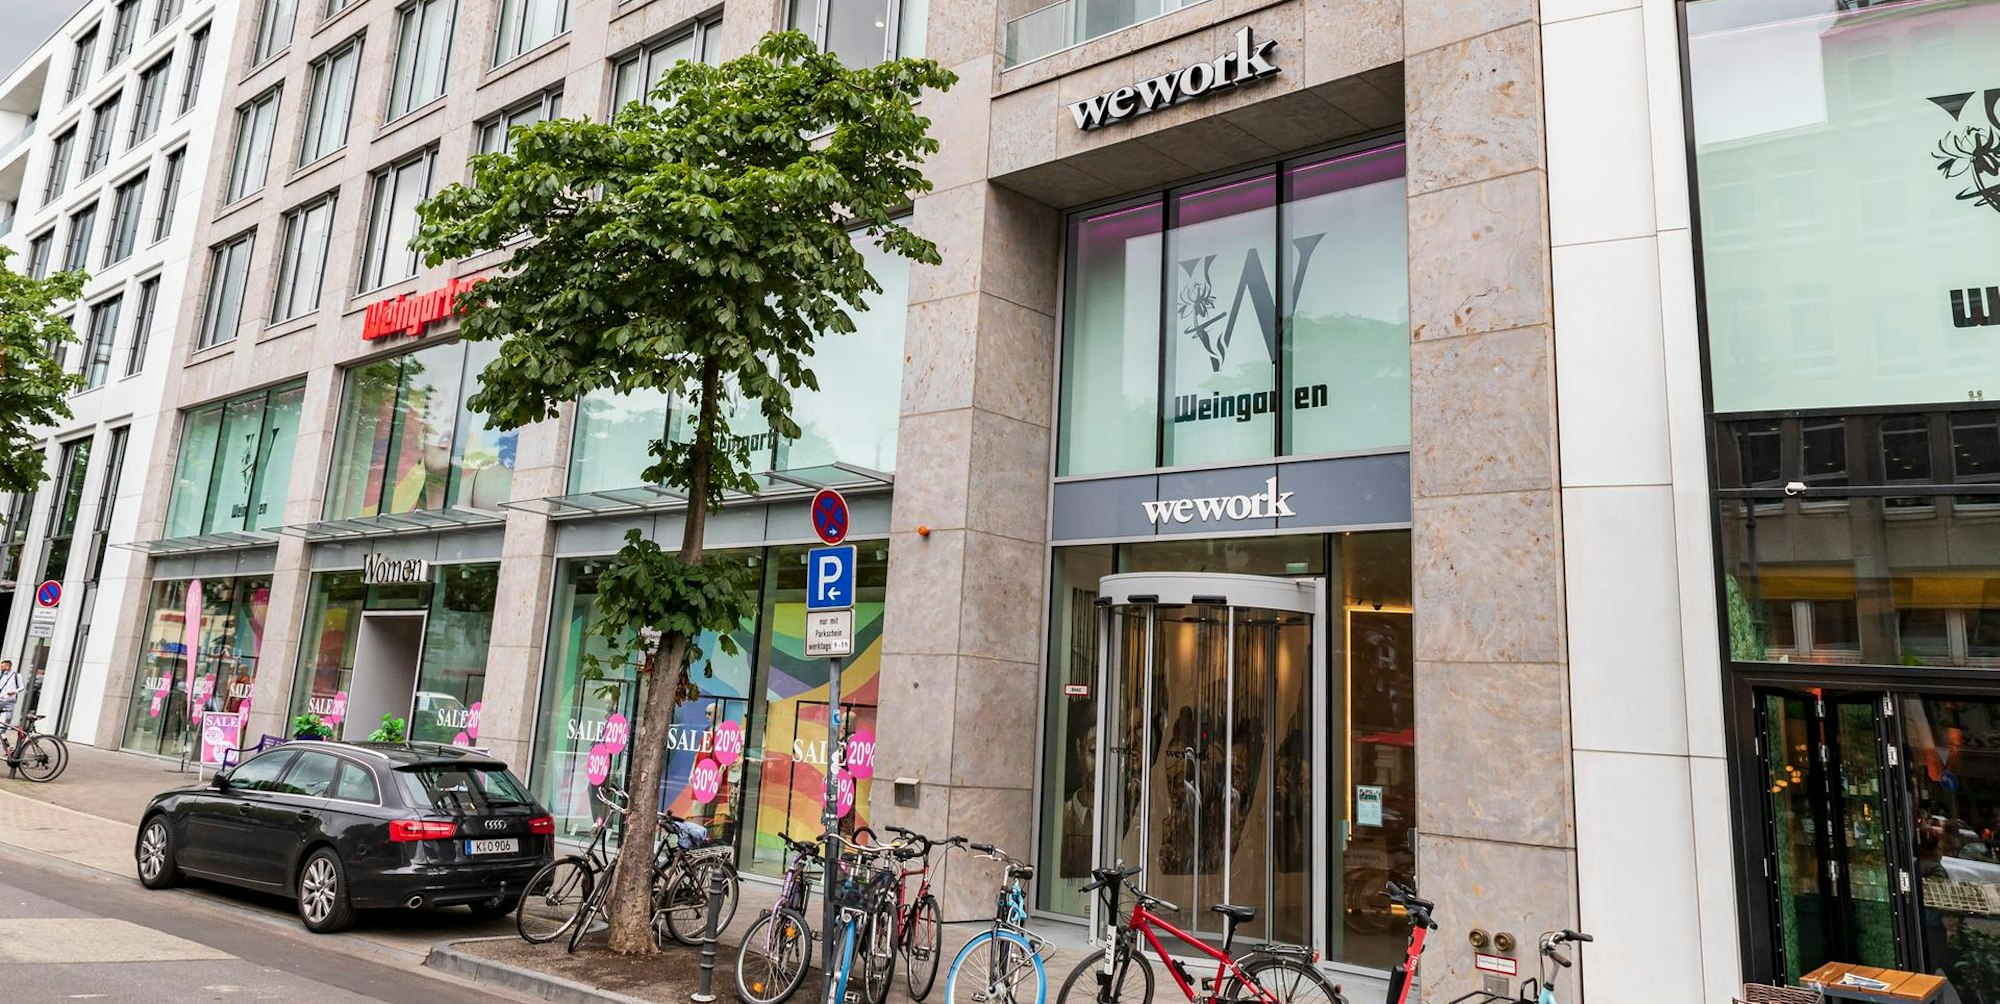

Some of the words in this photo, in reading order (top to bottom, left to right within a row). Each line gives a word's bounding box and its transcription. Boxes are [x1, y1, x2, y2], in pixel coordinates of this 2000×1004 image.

[1067, 26, 1281, 131] wework
[1142, 476, 1296, 525] wework
[363, 553, 425, 583] Women
[818, 556, 843, 600] P
[308, 697, 333, 715] SALE
[436, 708, 468, 729] SALE
[206, 715, 239, 728] SALE
[567, 719, 607, 742] SALE
[605, 722, 628, 745] 20%
[666, 727, 714, 753] SALE
[714, 729, 741, 754] 20%
[588, 755, 608, 777] 30%
[693, 768, 719, 794] 30%
